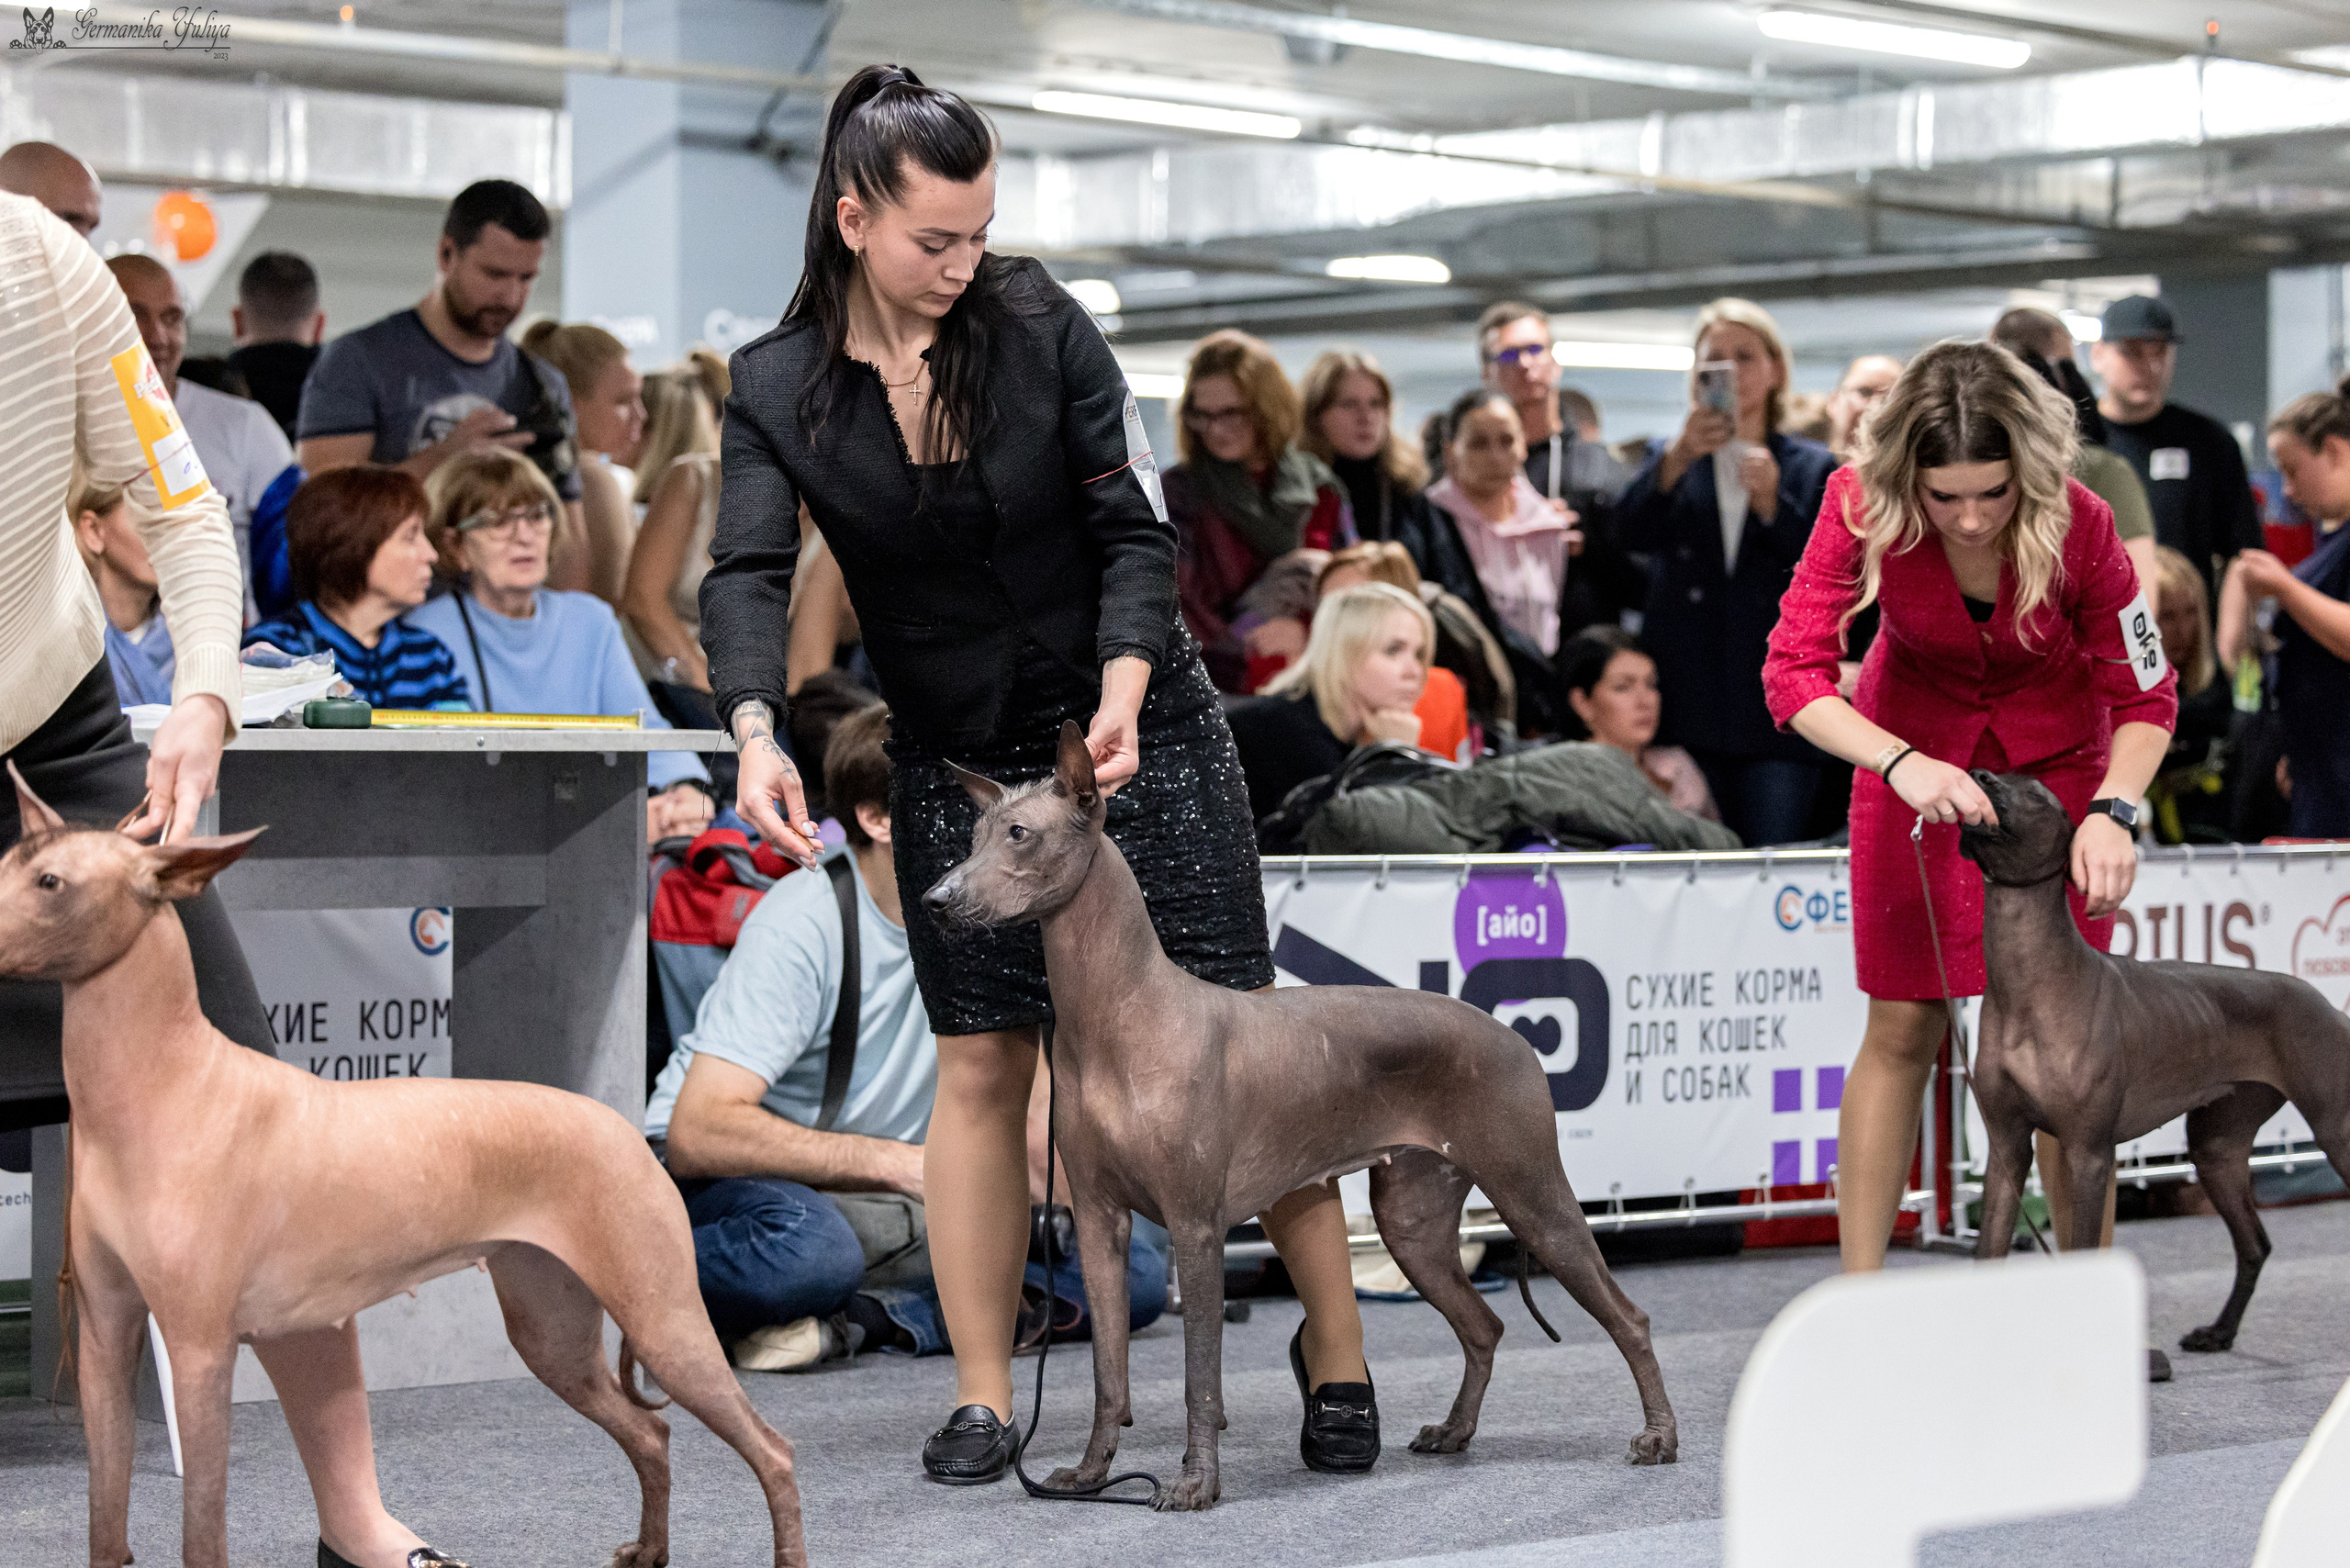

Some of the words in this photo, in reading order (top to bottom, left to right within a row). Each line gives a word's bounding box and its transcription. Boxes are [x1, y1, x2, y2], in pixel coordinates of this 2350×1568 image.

[1477, 904, 1548, 946] [айо]
[1626, 971, 1714, 1010] СУХИЕ
[1736, 967, 1821, 1006] КОРМА
[359, 998, 452, 1041] КОРМ
[1625, 1020, 1677, 1064] ДЛЯ
[1699, 1014, 1786, 1054] КОШЕК
[1626, 1070, 1641, 1104] И
[1662, 1064, 1751, 1103] СОБАК
